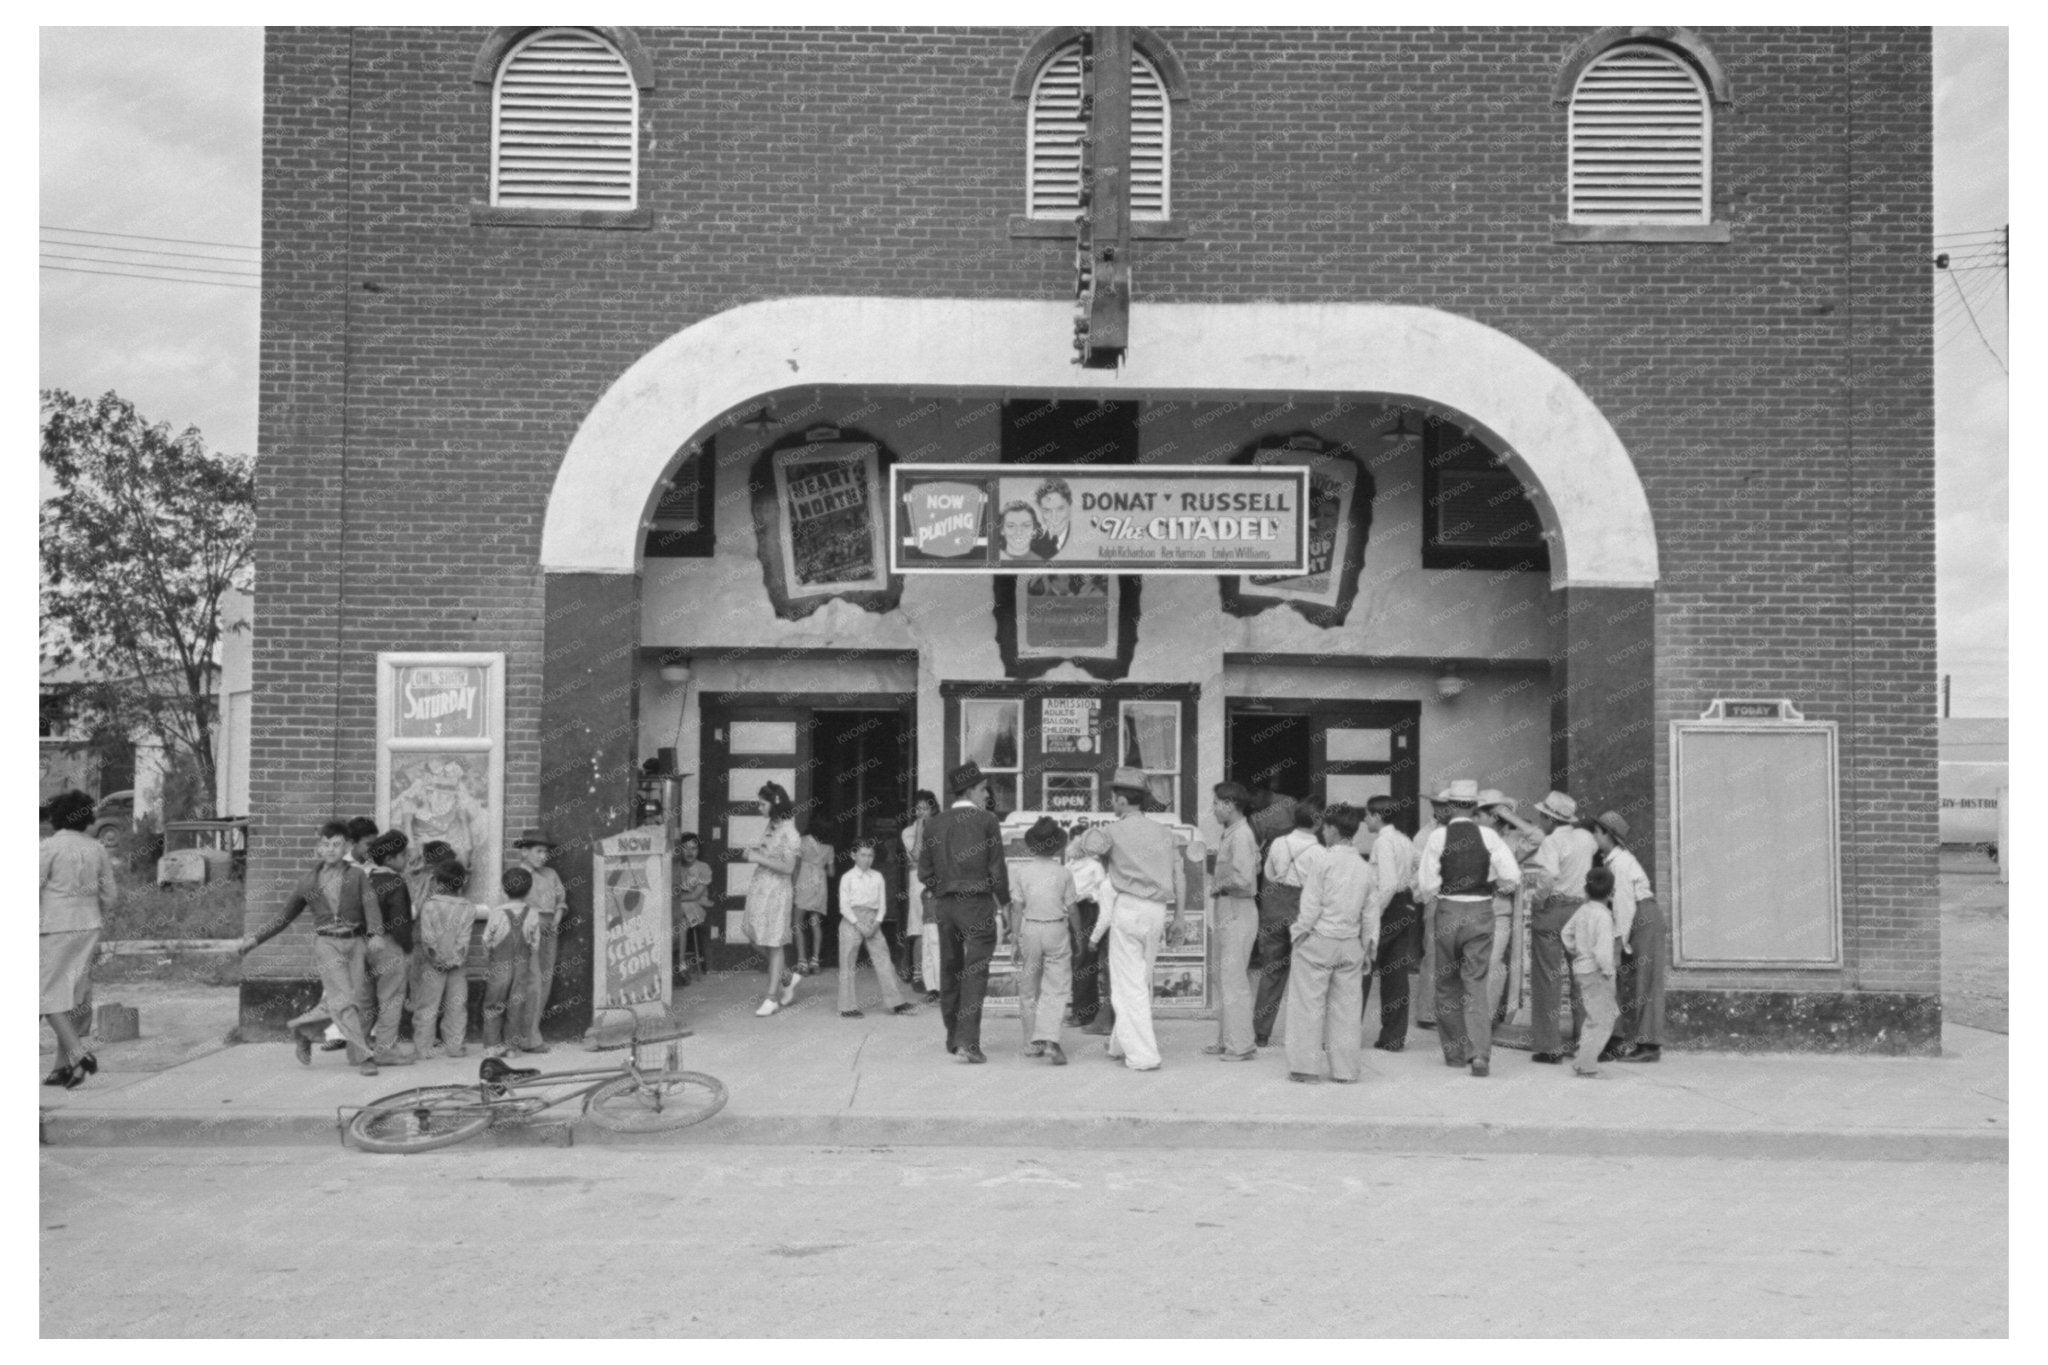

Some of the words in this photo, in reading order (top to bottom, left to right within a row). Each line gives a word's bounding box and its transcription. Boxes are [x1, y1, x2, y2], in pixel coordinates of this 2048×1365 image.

[791, 468, 851, 498] HEART
[798, 487, 860, 519] NORTH
[927, 494, 964, 509] NOW
[1081, 492, 1157, 511] DONAT
[1181, 493, 1290, 511] RUSSELL
[919, 512, 974, 549] PLAYING
[1117, 546, 1156, 559] Richardson
[1174, 546, 1206, 559] Harrison
[1234, 547, 1271, 559] Williams
[403, 681, 478, 720] SATURDAY
[1047, 699, 1097, 709] ADMISSION
[1732, 706, 1770, 715] TODAY
[1042, 726, 1081, 734] CHILDREN
[1052, 795, 1084, 806] OPEN
[618, 838, 652, 851] NOW
